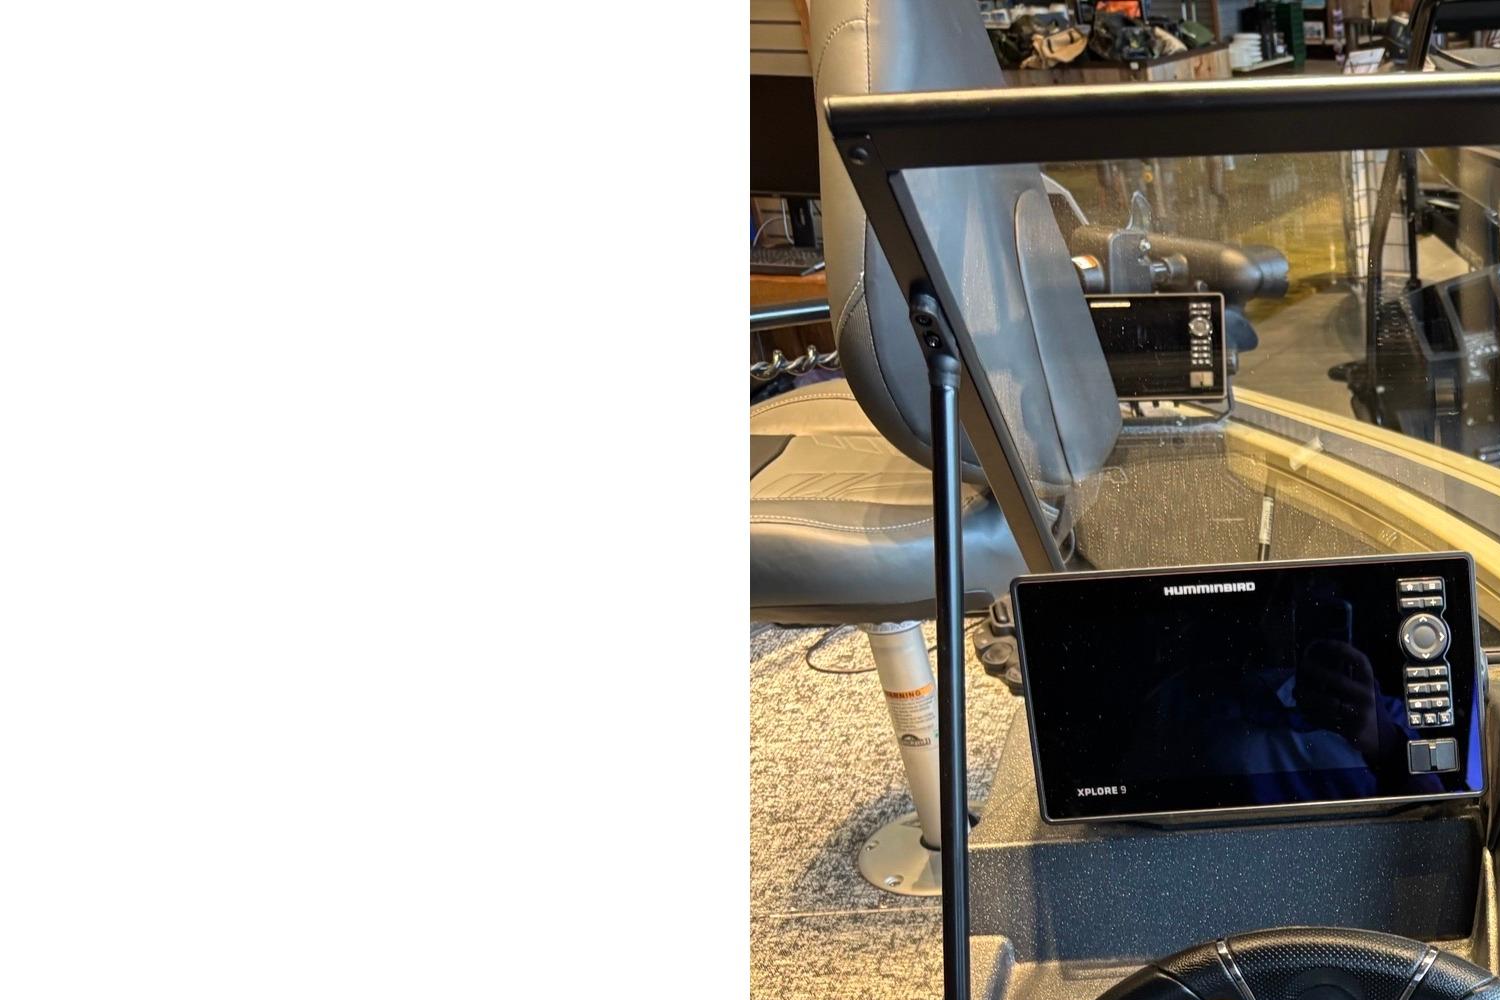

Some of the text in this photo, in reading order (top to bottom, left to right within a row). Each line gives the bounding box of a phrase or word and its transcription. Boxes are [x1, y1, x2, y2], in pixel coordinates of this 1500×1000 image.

[1163, 582, 1256, 596] HUMMINBIRD
[1077, 785, 1127, 797] XPLORE 9
